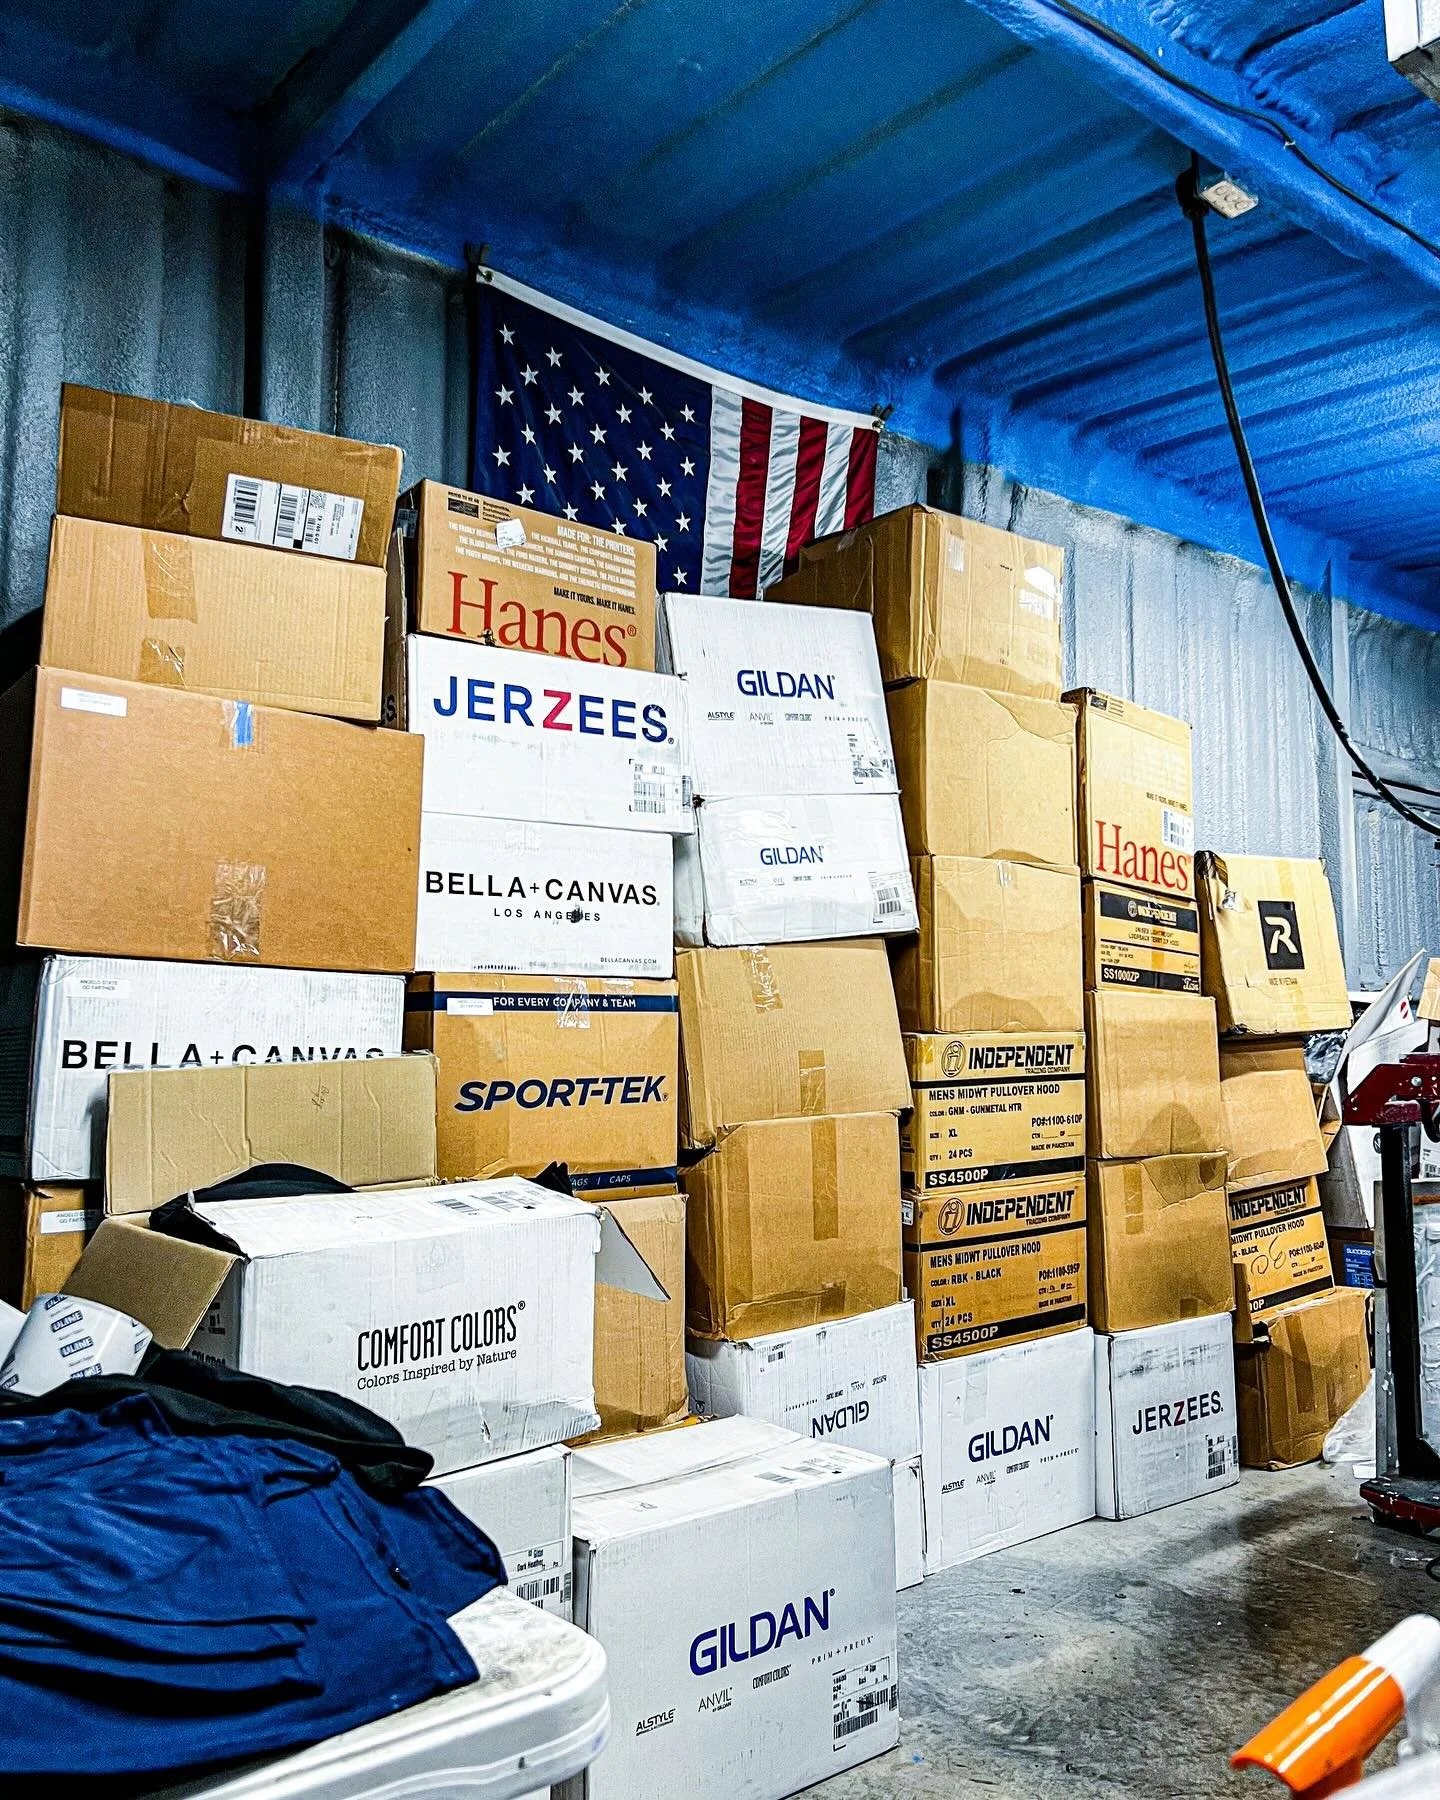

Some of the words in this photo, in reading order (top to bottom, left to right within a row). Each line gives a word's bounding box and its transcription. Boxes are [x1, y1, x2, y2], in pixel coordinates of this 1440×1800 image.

[554, 587, 569, 599] MAKE
[760, 845, 824, 866] GILDAN
[494, 907, 523, 917] LOS
[493, 997, 515, 1006] FOR
[518, 997, 549, 1007] EVERY
[602, 999, 608, 1007] &
[611, 999, 636, 1008] TEAM
[968, 1044, 1074, 1069] INDEPENDENT
[929, 1090, 955, 1101] MENS
[958, 1088, 988, 1100] MIDWT
[991, 1085, 1034, 1098] PULLOVER
[1037, 1083, 1060, 1095] HOOD
[948, 1106, 964, 1115] GNM
[970, 1104, 1007, 1114] GUNMETAL
[1009, 1103, 1022, 1112] HTR
[948, 1129, 958, 1137] XL
[948, 1150, 957, 1159] 24
[959, 1148, 972, 1158] PCS
[609, 1175, 631, 1184] CAPS
[929, 1168, 989, 1186] SS4500P
[966, 1190, 1075, 1226] INDEPENDENT
[1254, 1223, 1287, 1239] PULLOVER
[1288, 1218, 1305, 1231] HOOD
[930, 1255, 953, 1269] MENS
[955, 1250, 980, 1265] MIDWT
[983, 1244, 1020, 1261] PULLOVER
[1022, 1241, 1041, 1254] HOOD
[1241, 1245, 1259, 1257] BLACK
[951, 1275, 968, 1285] RBK
[976, 1268, 1002, 1281] BLACK
[945, 1296, 956, 1306] XL
[945, 1315, 955, 1327] 24
[958, 1312, 973, 1324] PCS
[357, 1318, 446, 1371] COMFORT
[931, 1325, 999, 1349] SS4500P
[357, 1372, 399, 1390] Colors
[402, 1360, 455, 1382] Inspired
[459, 1357, 473, 1371] by
[477, 1349, 517, 1366] Nature
[810, 1400, 870, 1438] GILDAN
[698, 1687, 733, 1712] ANVIL
[636, 1708, 676, 1732] ALSTYLE
